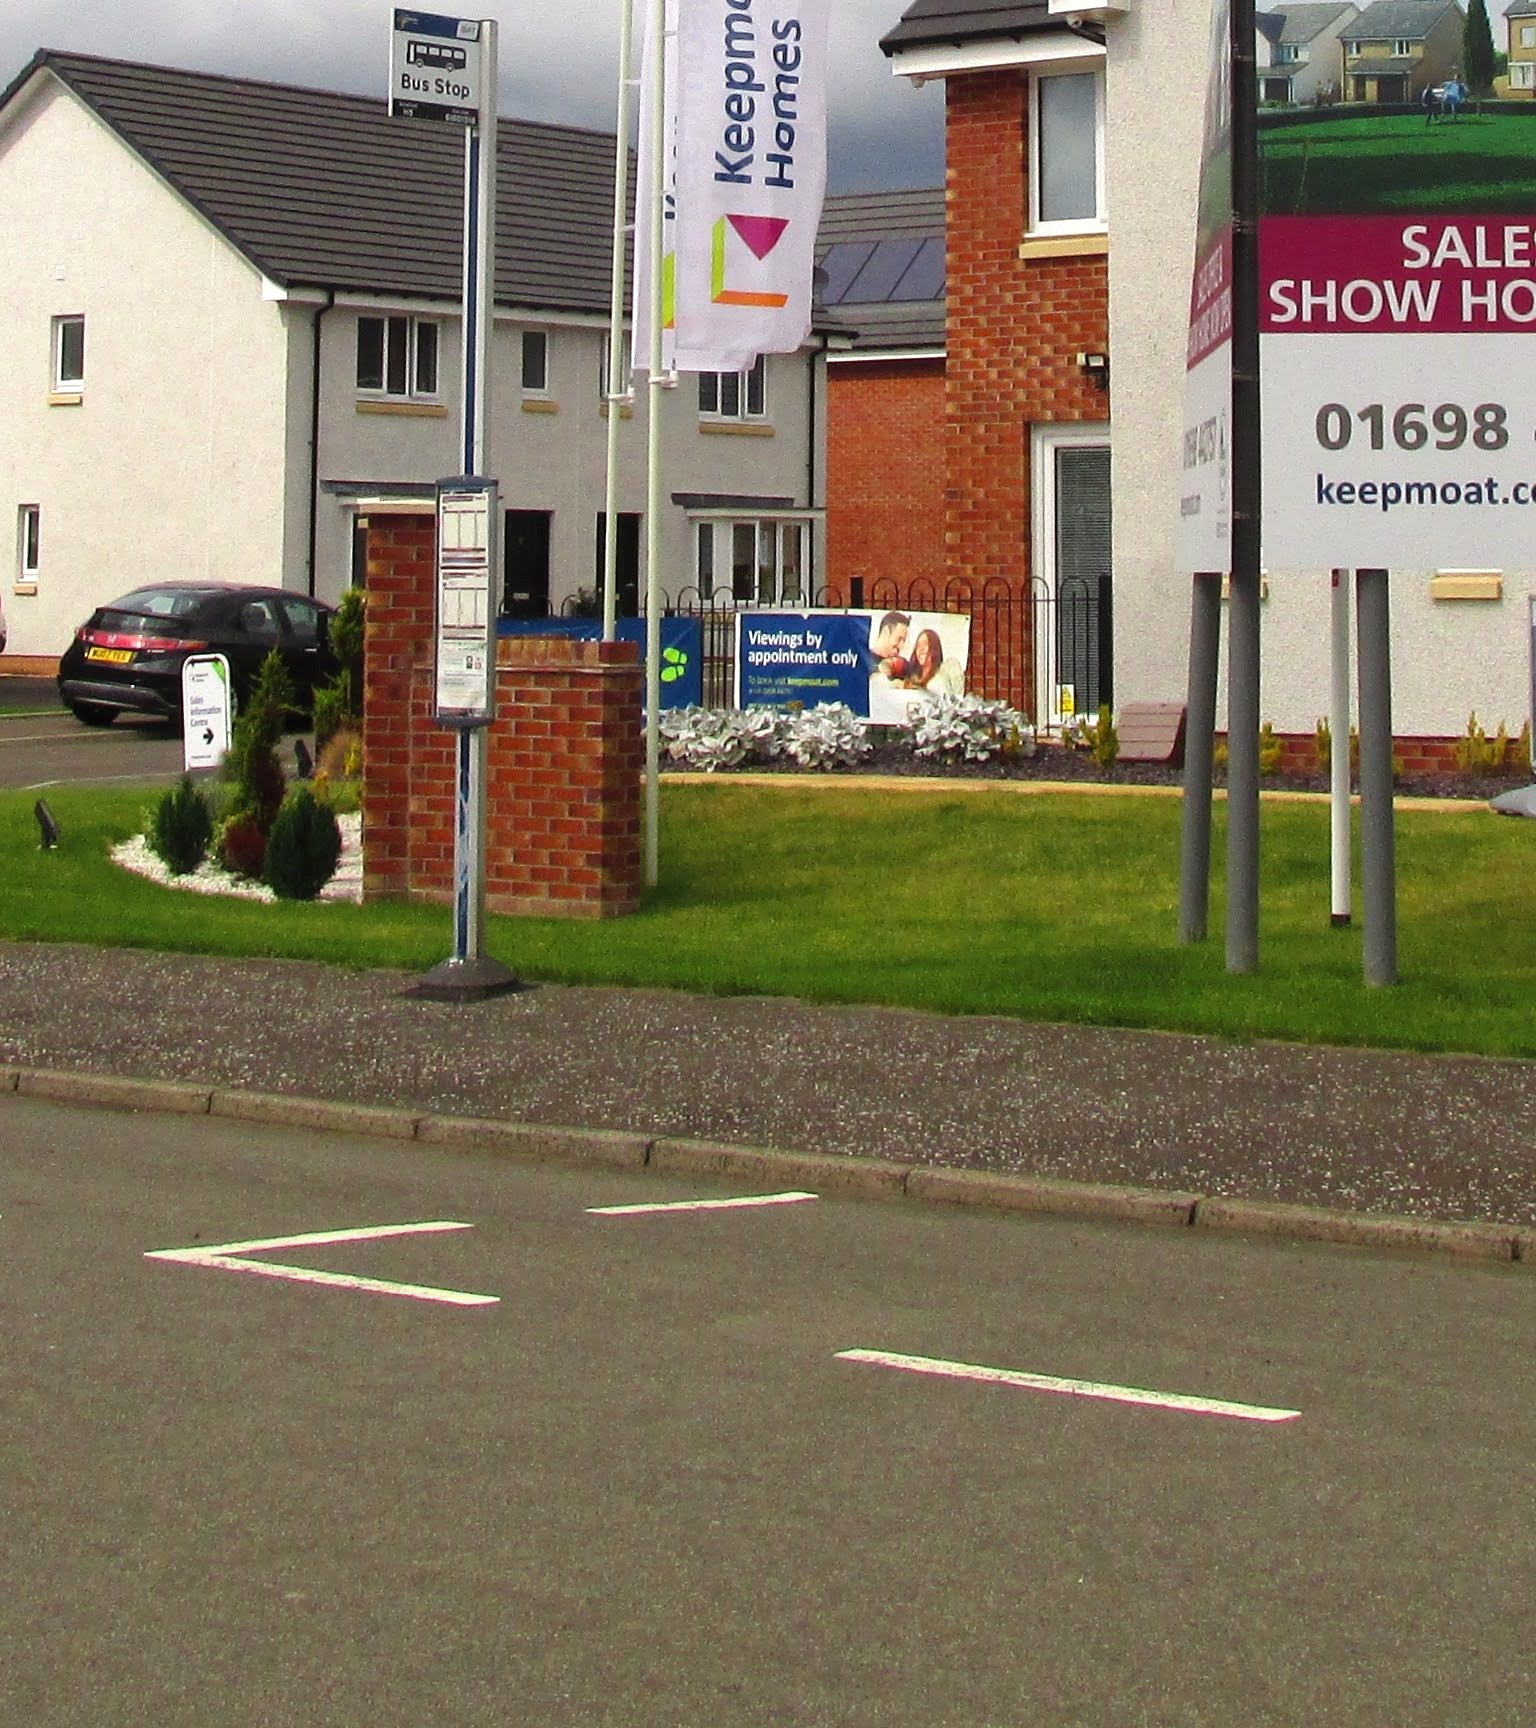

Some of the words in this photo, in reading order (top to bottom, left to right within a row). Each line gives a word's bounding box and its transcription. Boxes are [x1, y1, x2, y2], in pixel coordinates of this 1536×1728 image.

[401, 73, 429, 92] Bus
[435, 78, 470, 100] Stop
[764, 17, 802, 189] Homes
[1269, 278, 1440, 325] SHOW
[1315, 403, 1509, 451] 01698
[748, 630, 803, 648] Viewings
[806, 631, 822, 649] by
[748, 648, 827, 666] appointment
[831, 649, 858, 668] only
